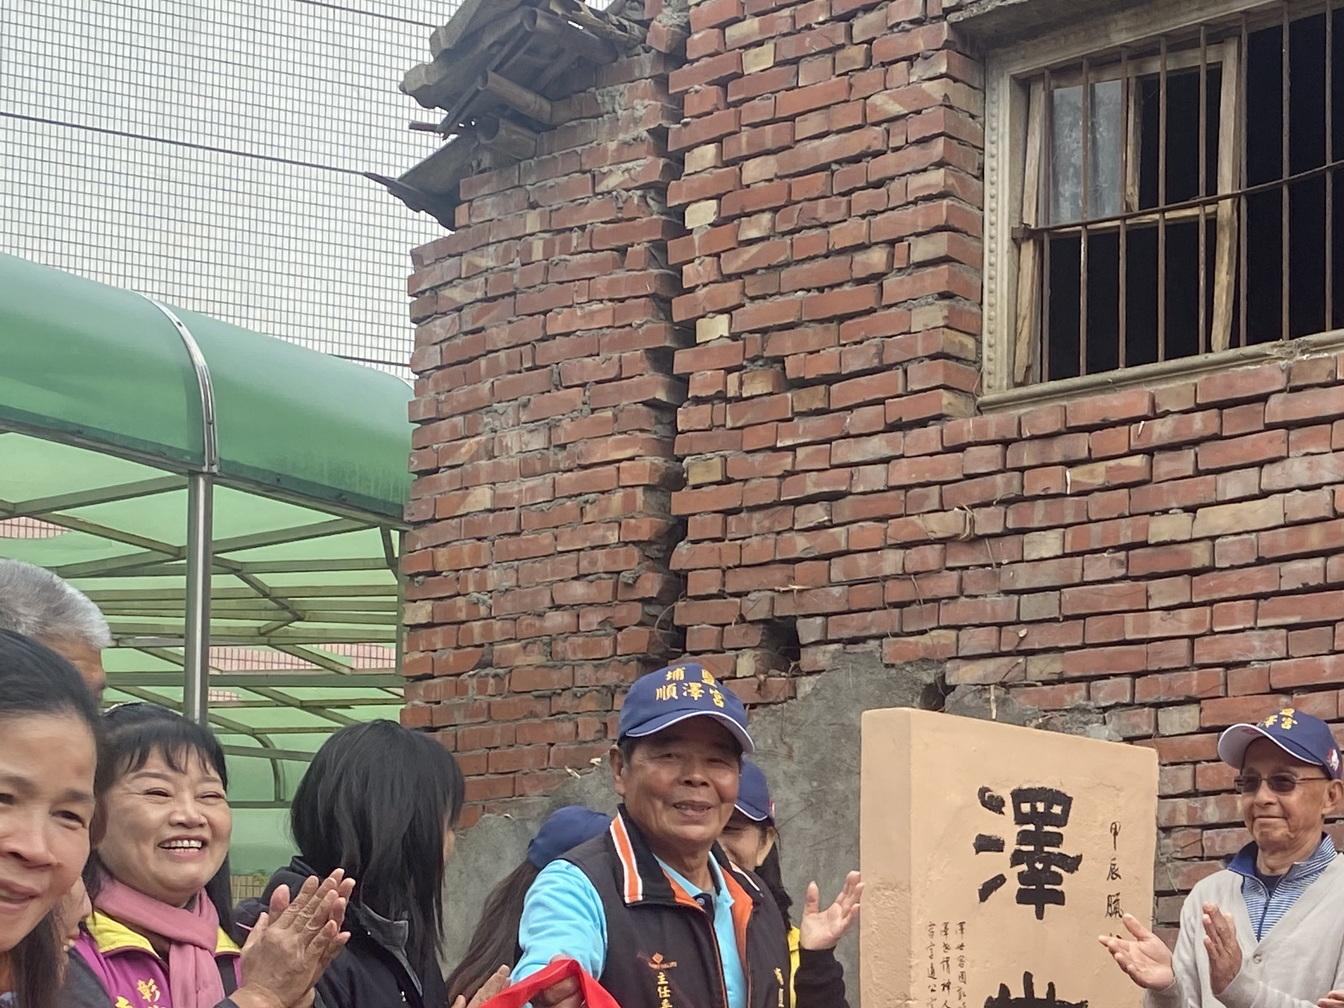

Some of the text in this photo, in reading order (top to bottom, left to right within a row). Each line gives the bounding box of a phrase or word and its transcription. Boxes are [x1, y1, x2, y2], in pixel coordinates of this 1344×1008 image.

[655, 681, 726, 708] 順澤宮
[1105, 821, 1124, 940] 甲辰臘
